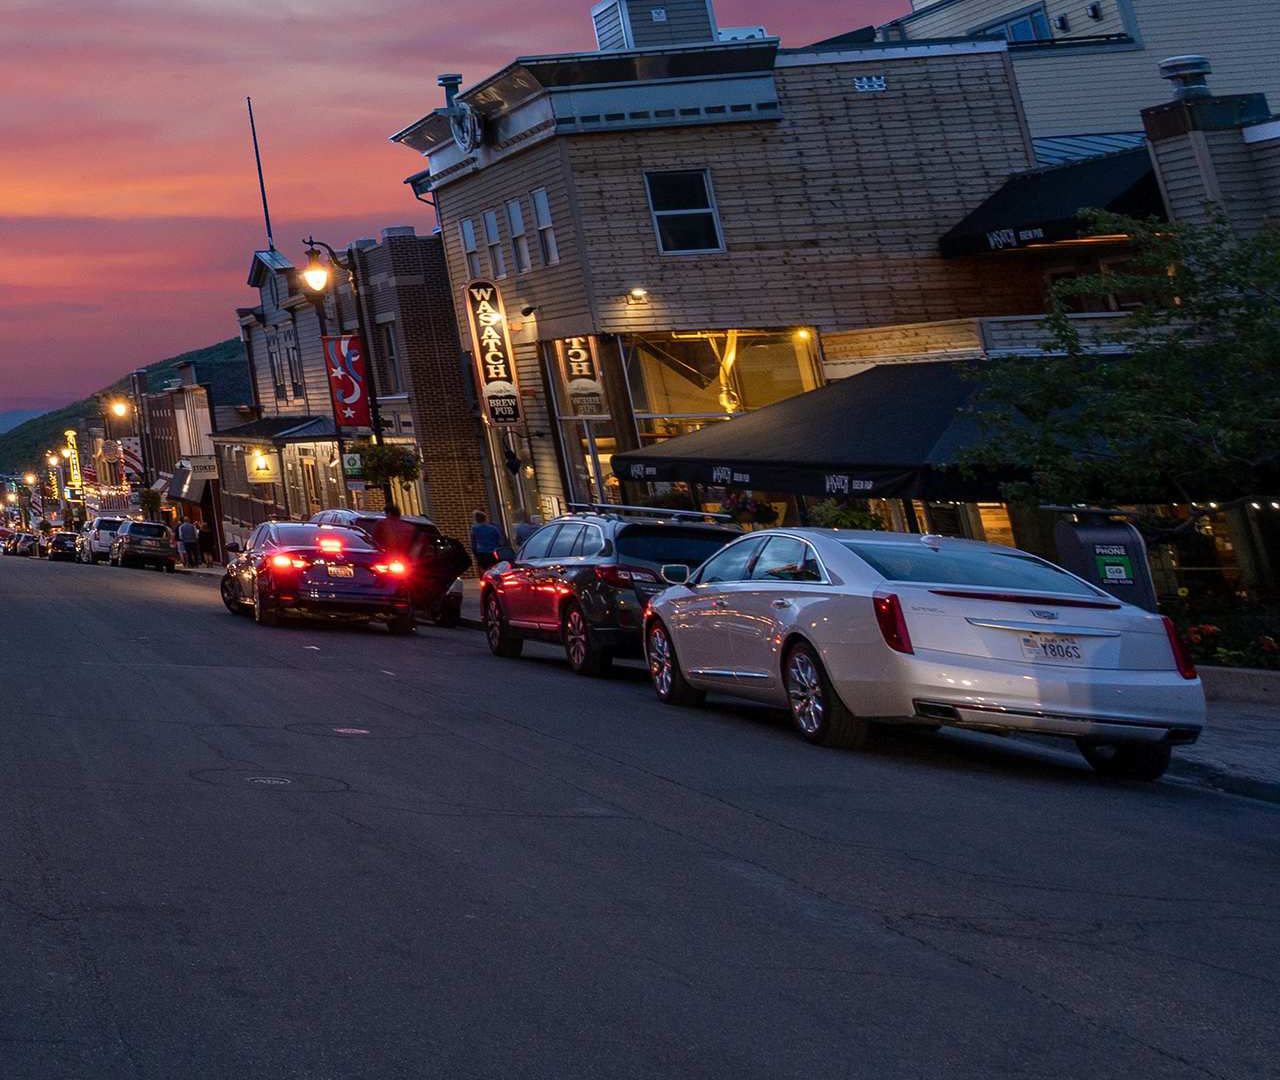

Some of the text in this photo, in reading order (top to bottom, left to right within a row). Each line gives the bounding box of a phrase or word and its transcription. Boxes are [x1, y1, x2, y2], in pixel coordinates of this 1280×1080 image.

[470, 287, 508, 379] WASATCH
[489, 398, 516, 408] BREW
[495, 407, 514, 416] PUB
